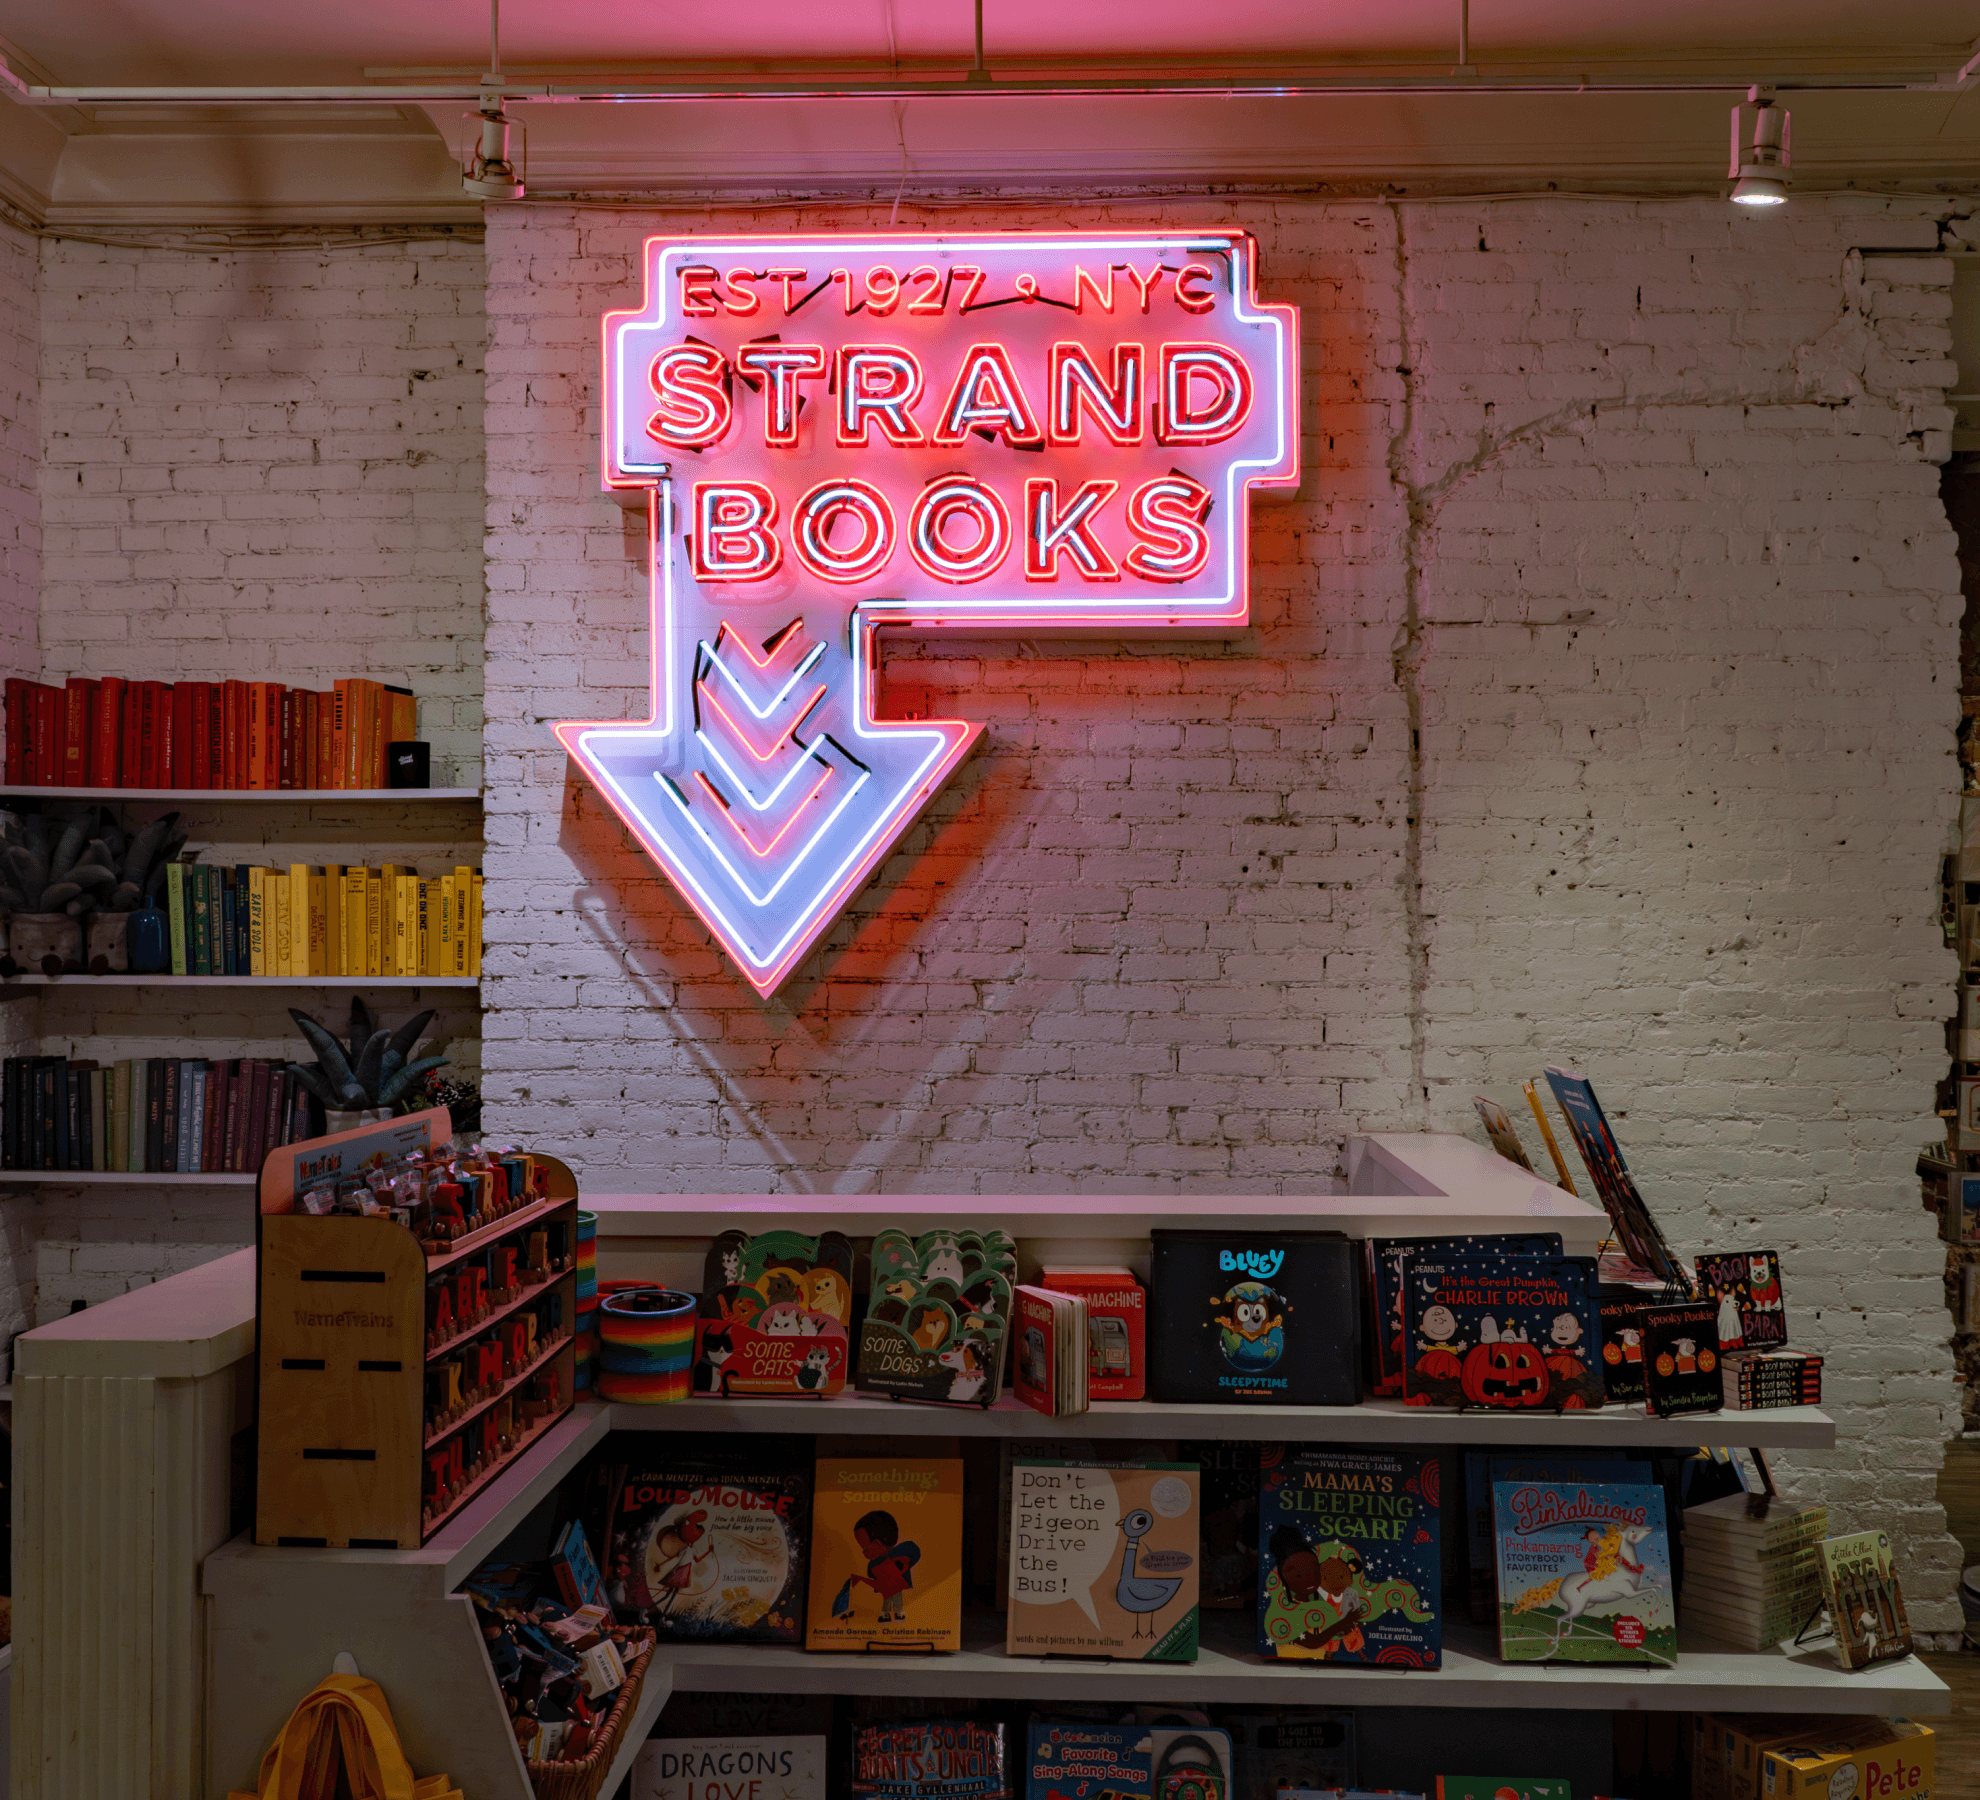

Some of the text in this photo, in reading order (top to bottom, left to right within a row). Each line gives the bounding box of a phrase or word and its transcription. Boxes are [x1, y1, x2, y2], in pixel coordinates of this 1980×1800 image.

[680, 264, 1216, 315] EST 1927 NYC
[646, 342, 1254, 448] STRAND
[692, 477, 1212, 584] BOOKS
[212, 706, 221, 746] JOHANSEN
[252, 893, 261, 918] BABY
[368, 882, 379, 935] THE SEVEN HILLS
[419, 883, 427, 930] ONE ON ONE
[457, 889, 465, 920] SHAMELESS
[310, 906, 318, 952] DEPARTURES
[397, 920, 405, 937] JELLY
[252, 929, 262, 953] SOLO
[1385, 1246, 1415, 1255] PEANUTS
[1415, 1265, 1445, 1274] PEANUTS
[1708, 1254, 1748, 1287] BOO!
[1441, 1275, 1560, 1289] It's the Great Pumpkin,
[1087, 1291, 1142, 1308] MACHINE
[1434, 1289, 1569, 1307] CHARLIE BROWN
[294, 1311, 393, 1328] NameTrains
[1648, 1310, 1715, 1327] Spooky Pookie
[1743, 1313, 1784, 1339] BARK!
[743, 1341, 796, 1358] SOME
[863, 1336, 907, 1354] SOME
[753, 1359, 796, 1376] CATS
[880, 1354, 923, 1374] DOGS
[1218, 1376, 1288, 1388] SLEEPYTIME
[1660, 1392, 1718, 1408] by Sandra Boynton
[1009, 1442, 1069, 1458] Don't
[1301, 1452, 1347, 1460] CHIMAMANDA
[1369, 1455, 1395, 1463] ADICHIE
[1320, 1460, 1341, 1469] NWA
[1342, 1461, 1403, 1472] GRACE-JAMES
[641, 1473, 782, 1484] CARA MENTZEL IDINA MENZEL
[837, 1468, 939, 1490] Something,
[1021, 1472, 1086, 1489] Don't
[1303, 1471, 1394, 1493] MAMA'S
[623, 1485, 795, 1518] LOUD MOUSE
[842, 1486, 929, 1505] someday
[1020, 1492, 1105, 1510] Let the
[1279, 1489, 1414, 1518] SLEEPING
[1511, 1488, 1646, 1530] Pinkalicious
[737, 1514, 753, 1523] little
[1020, 1513, 1100, 1533] Pigeon
[1318, 1515, 1408, 1542] SCARF
[1019, 1534, 1086, 1551] Drive
[1504, 1537, 1583, 1560] Pinkamazing
[1831, 1541, 1873, 1561] Little Elliot
[1019, 1555, 1058, 1571] the
[1506, 1553, 1565, 1563] STORYBOOK
[1506, 1564, 1558, 1573] FAVORITES
[1017, 1577, 1067, 1593] Bus!
[1368, 1632, 1423, 1642] JOELLE AVELINO
[1378, 1625, 1405, 1633] Illustrated
[1016, 1635, 1034, 1643] words
[1050, 1636, 1076, 1645] pictures
[1077, 1637, 1085, 1646] by
[1099, 1637, 1124, 1646] willems
[1152, 1641, 1169, 1657] READ
[712, 1708, 780, 1732] LOVE
[857, 1726, 998, 1759] SECRET SOCIETY
[1061, 1747, 1118, 1762] Favorite
[662, 1750, 794, 1779] DRAGONS
[859, 1752, 924, 1781] AUNTS
[926, 1759, 935, 1773] &
[1033, 1763, 1148, 1783] Sing-Along Songs
[881, 1780, 986, 1795] JAKE GYLLENHAAL
[1866, 1758, 1921, 1800] Pete
